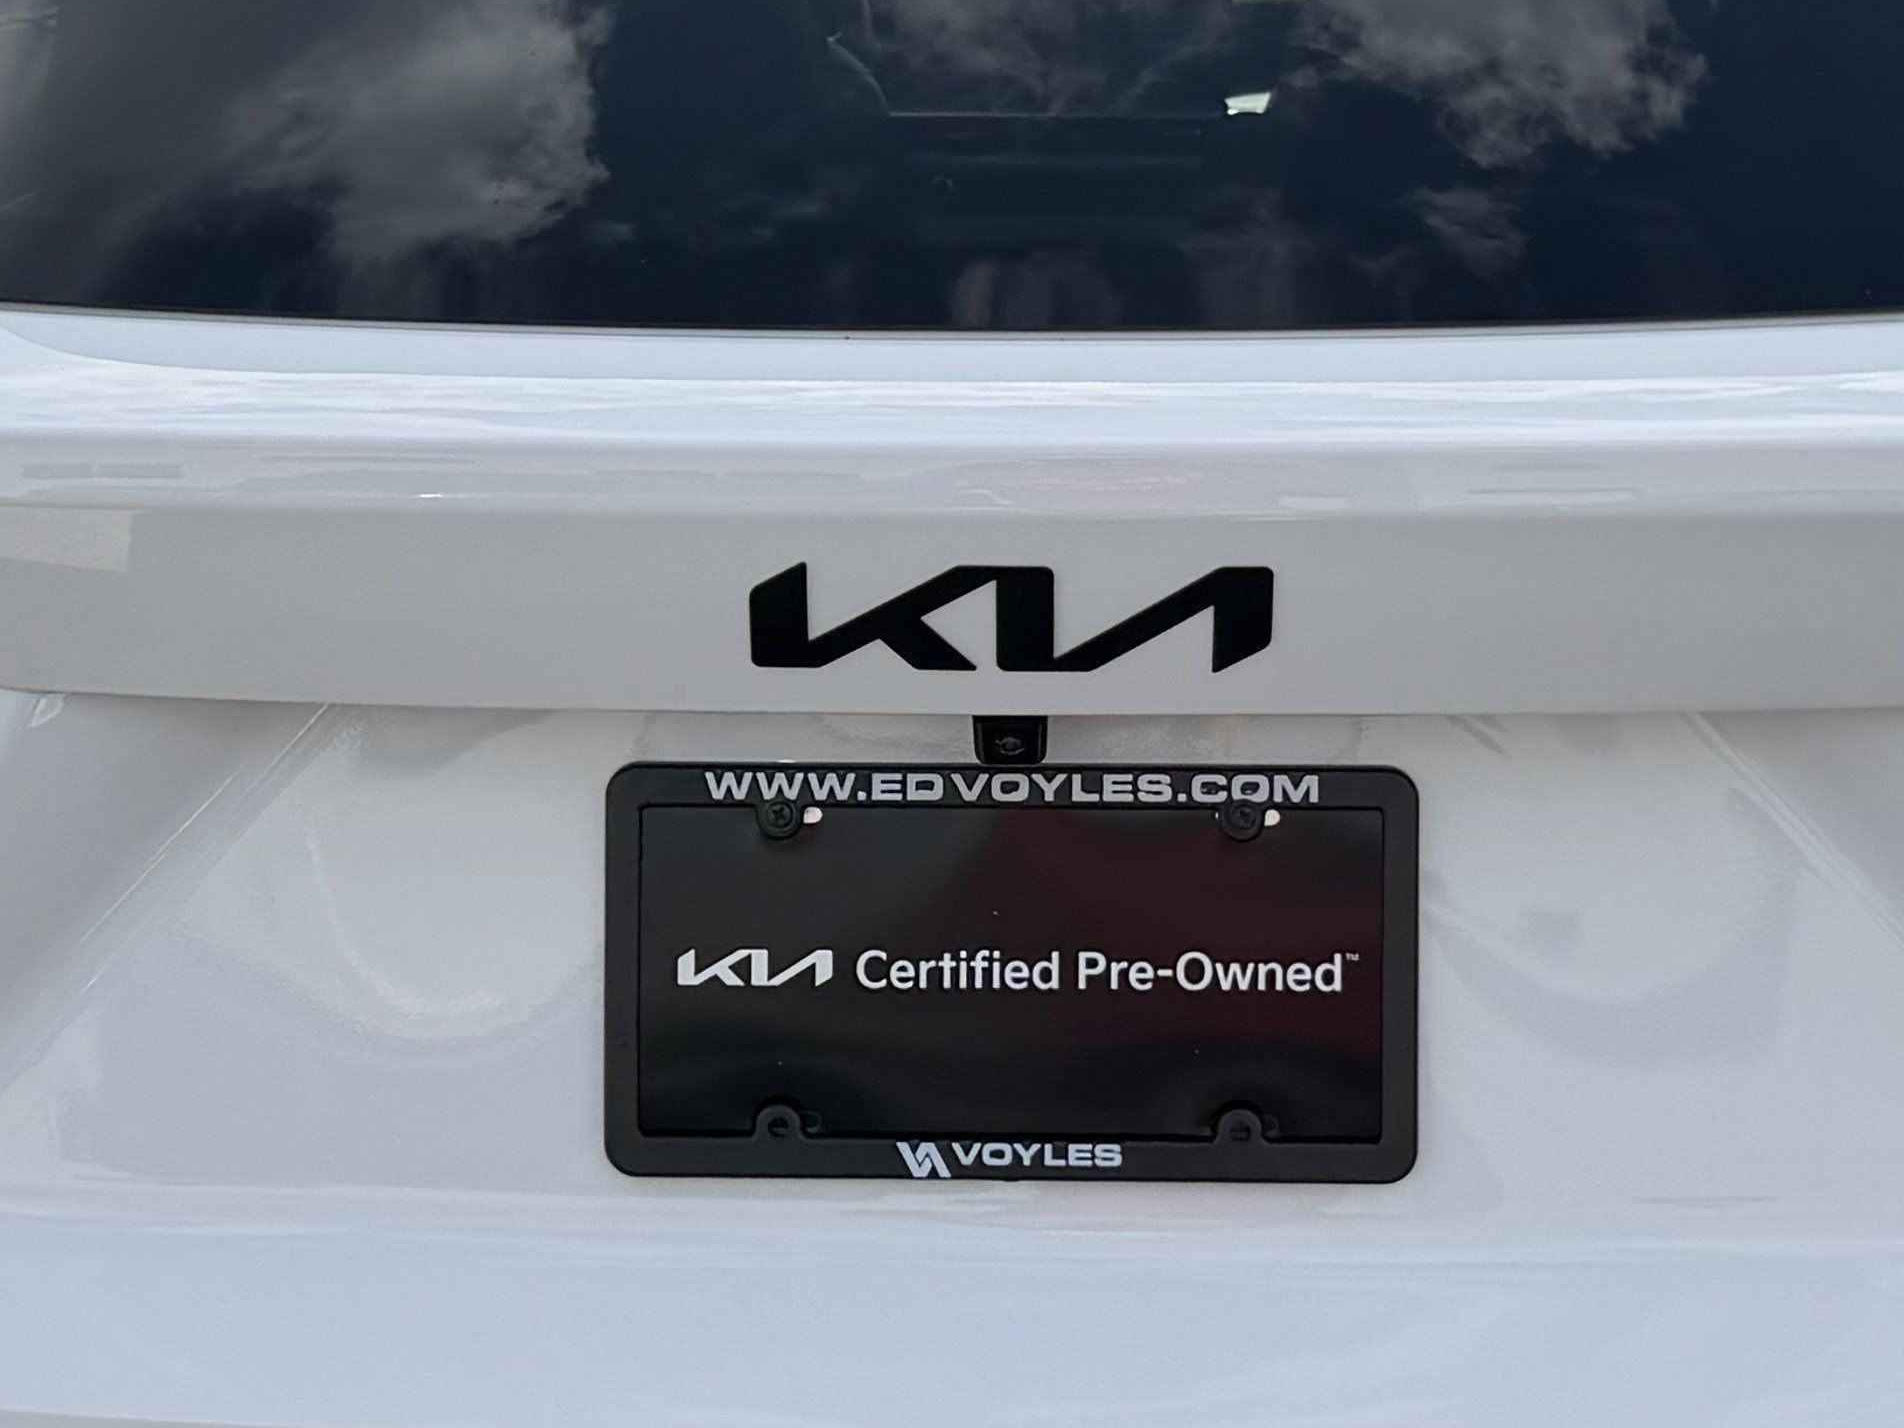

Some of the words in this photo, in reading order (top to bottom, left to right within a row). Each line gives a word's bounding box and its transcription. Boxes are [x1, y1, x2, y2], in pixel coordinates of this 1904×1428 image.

[748, 561, 1274, 673] KIA
[676, 948, 834, 987] KIA
[855, 948, 1059, 991] Certified
[951, 1141, 1124, 1168] VOYLES
